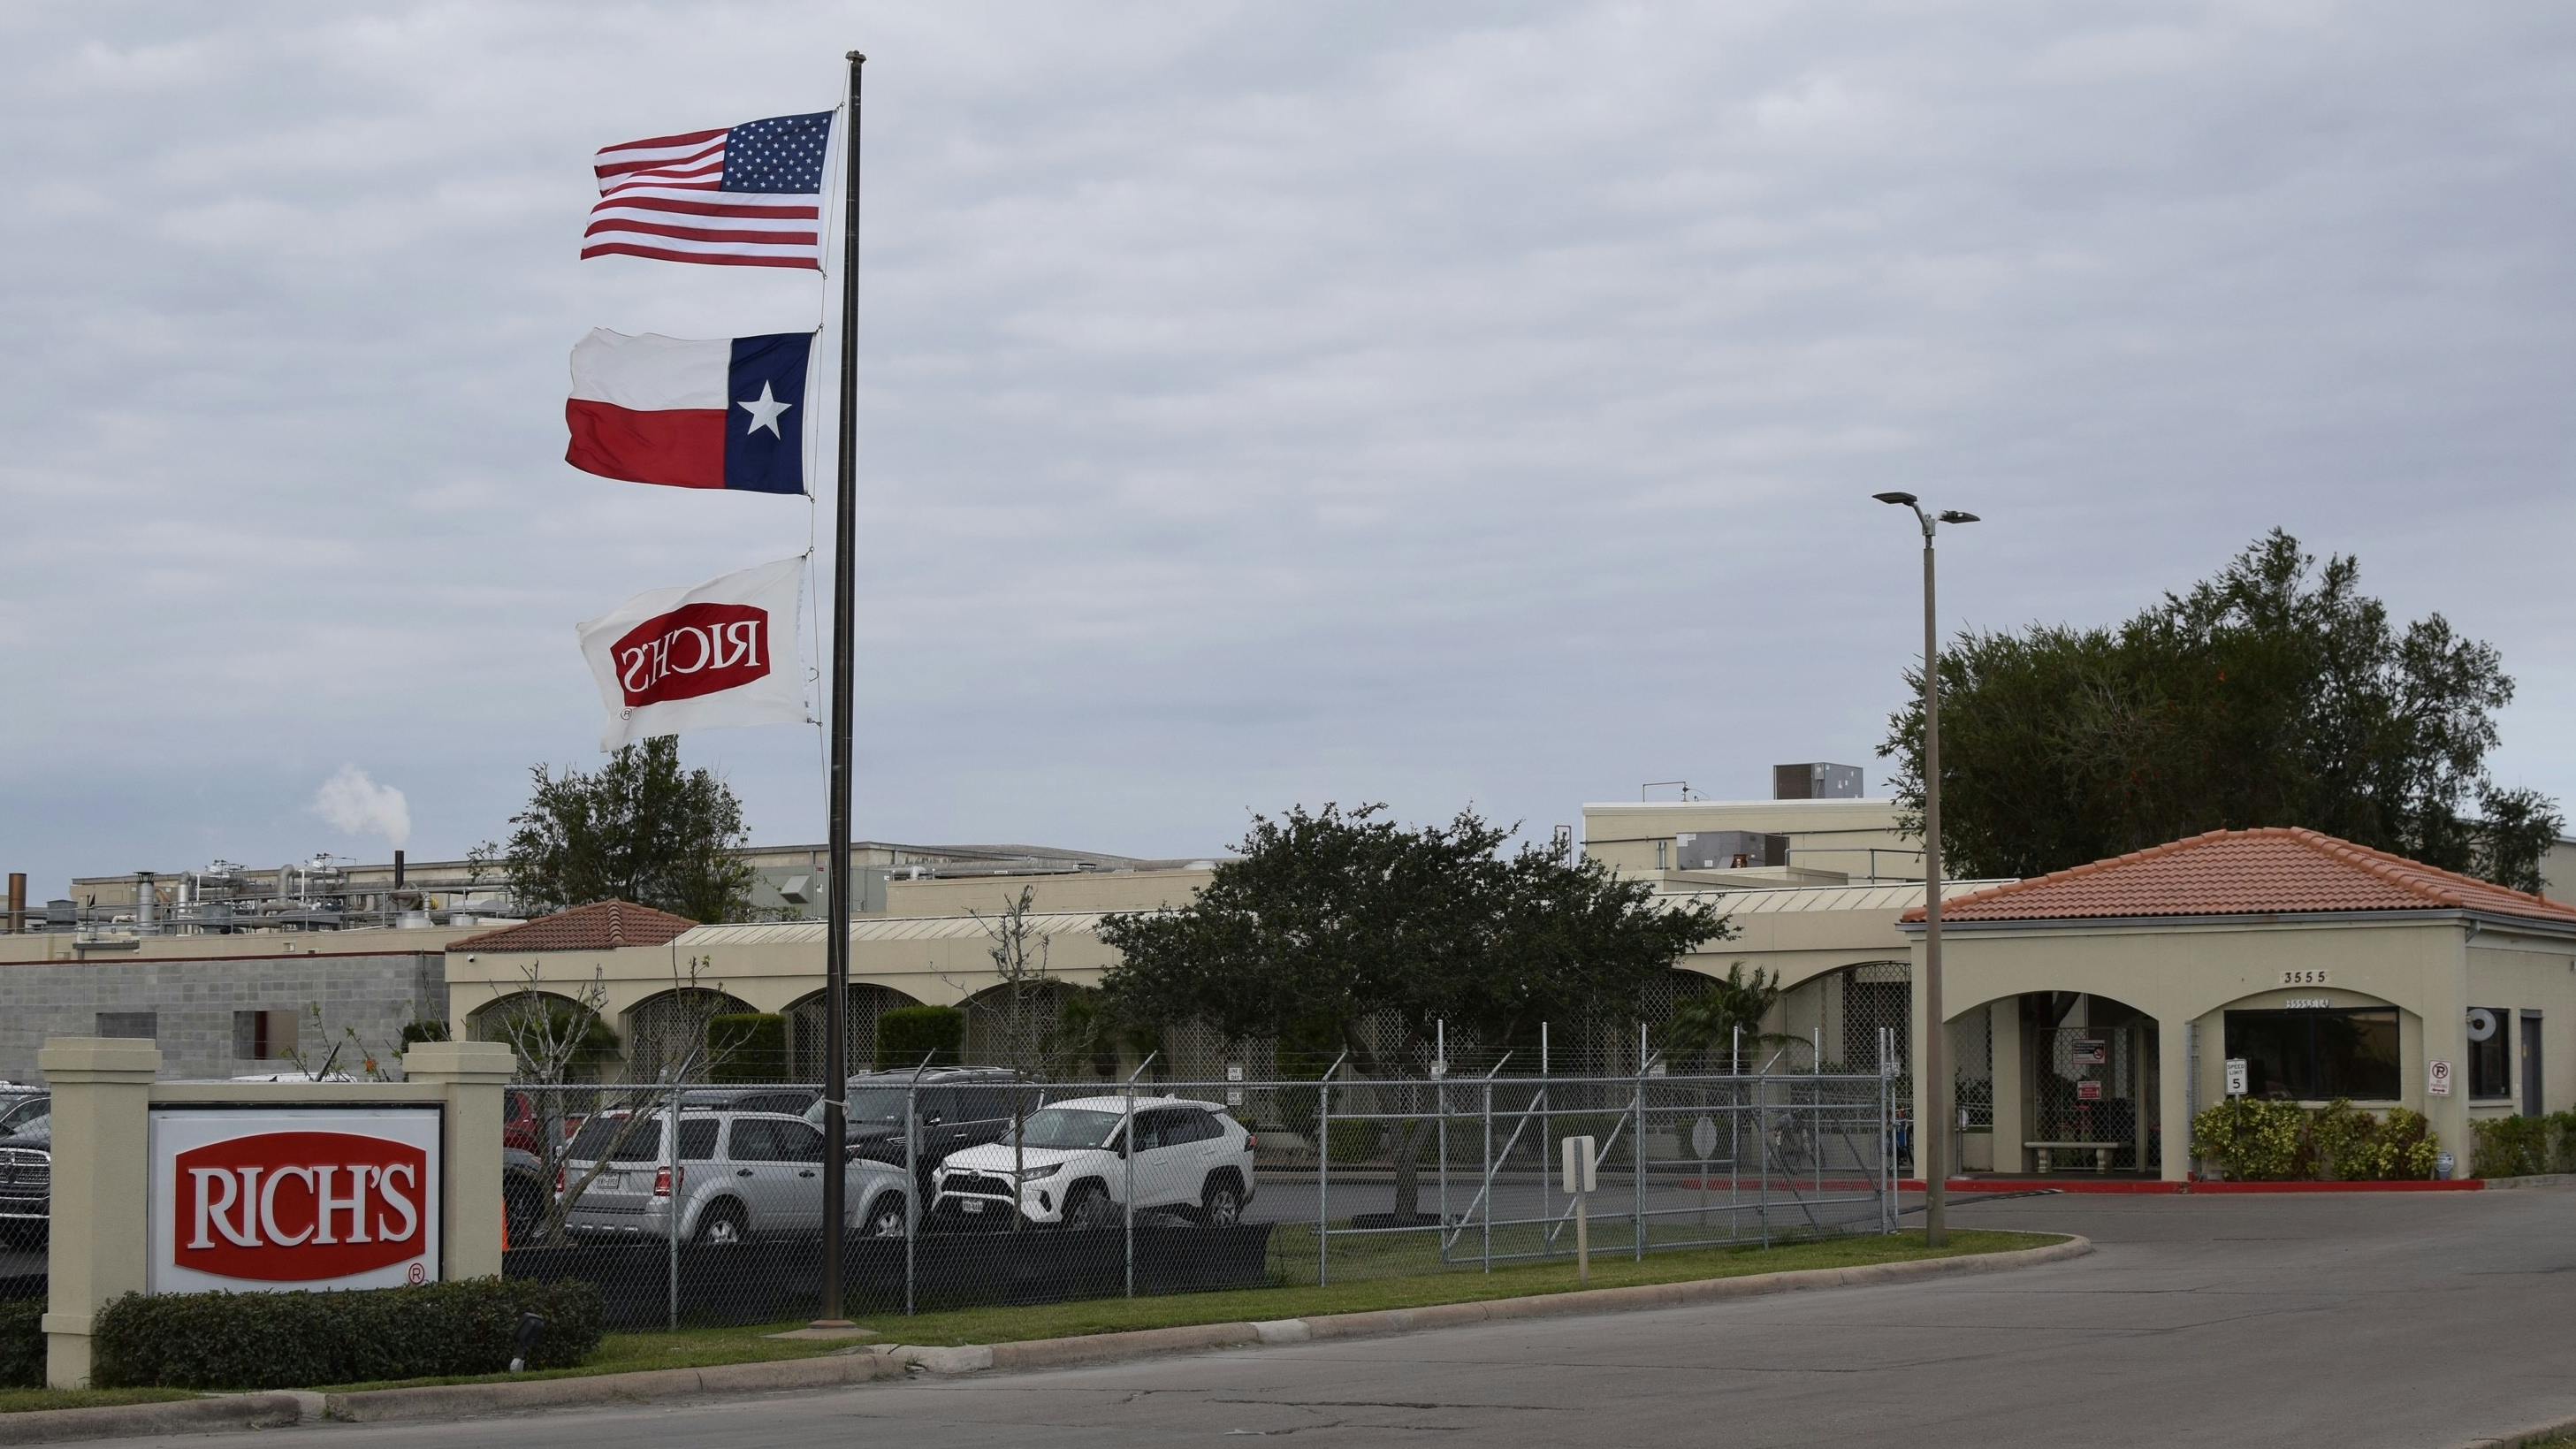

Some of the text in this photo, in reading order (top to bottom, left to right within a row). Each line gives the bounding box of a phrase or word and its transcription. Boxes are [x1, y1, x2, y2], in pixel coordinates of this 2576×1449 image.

[2284, 971, 2325, 983] 3555
[2232, 1078, 2241, 1089] 5
[187, 1163, 417, 1249] RICH'S
